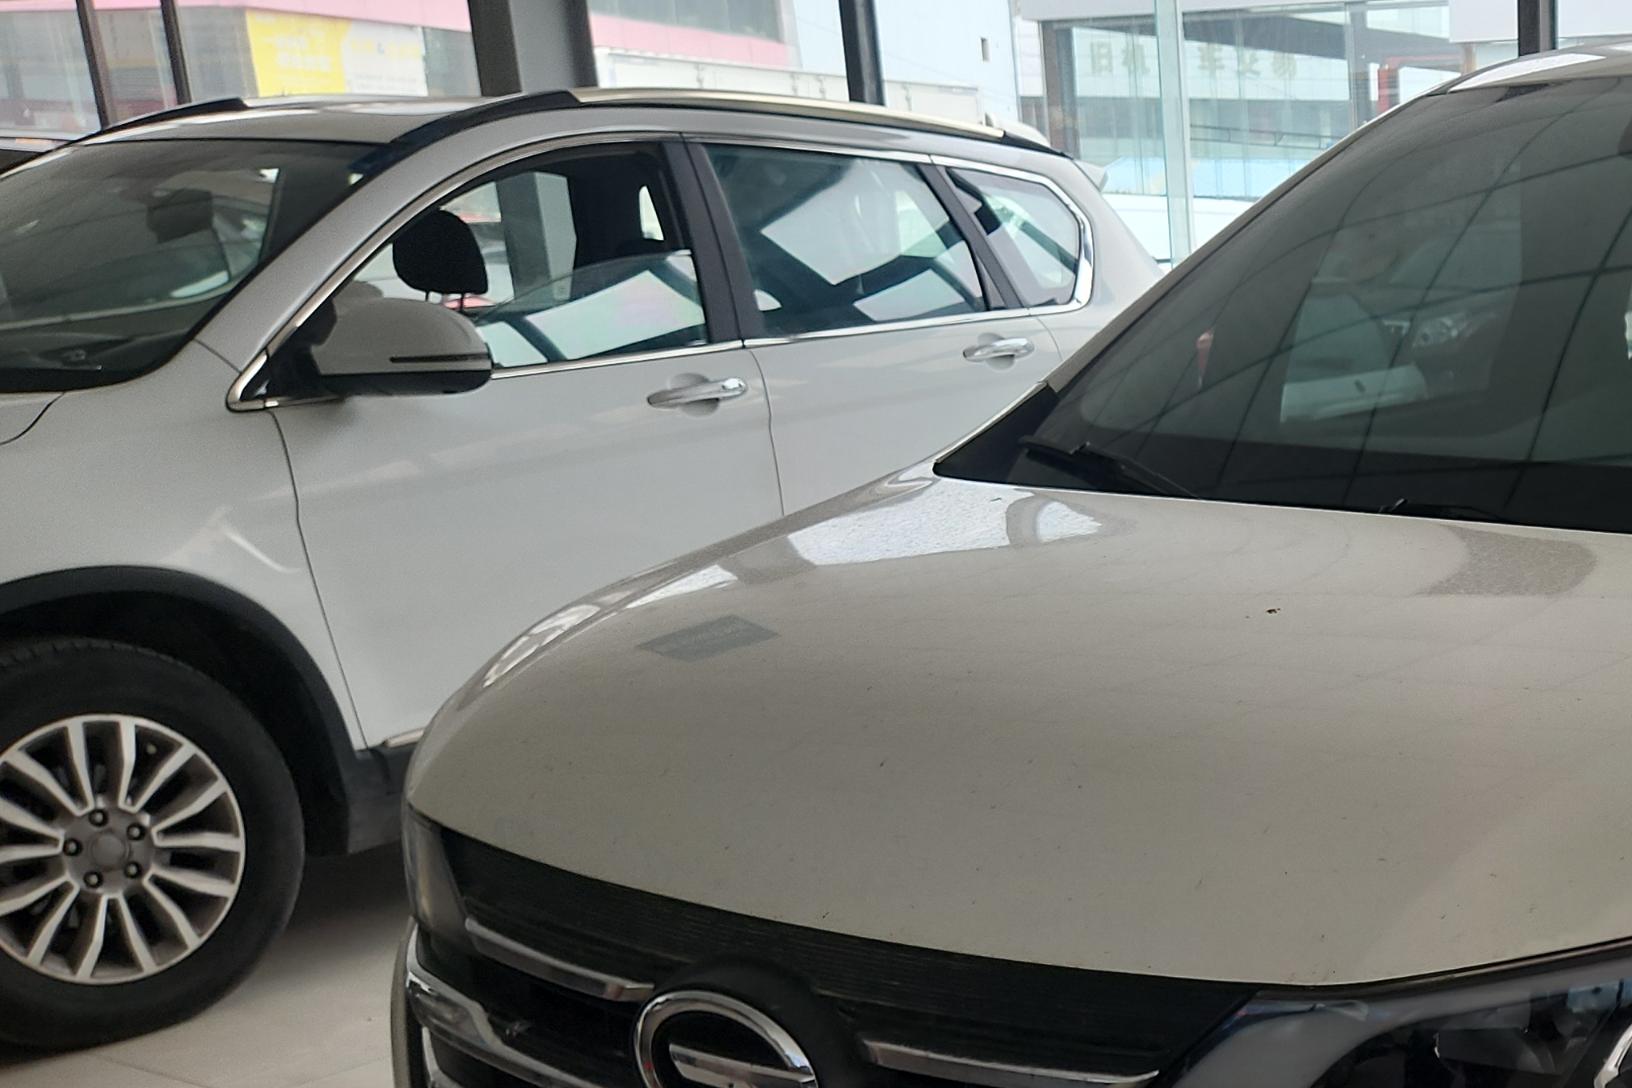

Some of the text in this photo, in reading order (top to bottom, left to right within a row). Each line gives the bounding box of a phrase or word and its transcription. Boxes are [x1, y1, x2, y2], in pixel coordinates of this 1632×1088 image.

[1090, 41, 1298, 79] 旧机车交易
